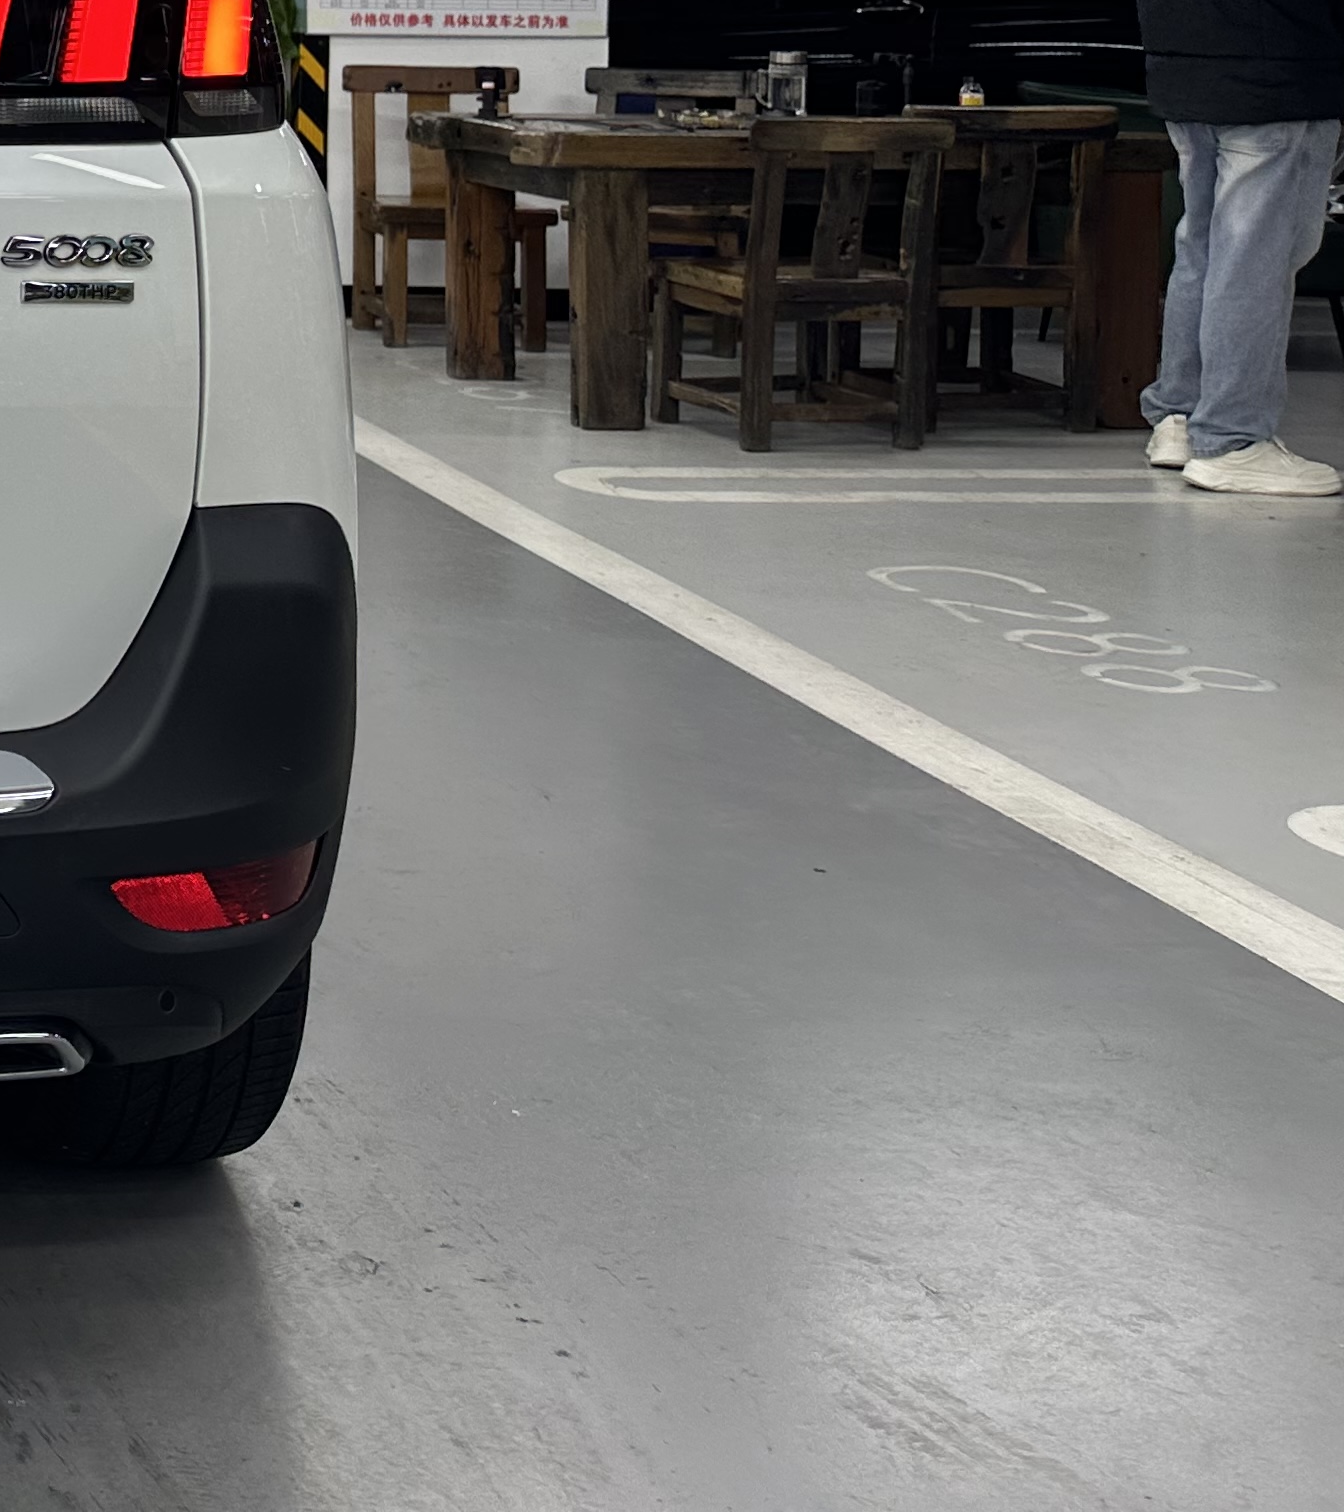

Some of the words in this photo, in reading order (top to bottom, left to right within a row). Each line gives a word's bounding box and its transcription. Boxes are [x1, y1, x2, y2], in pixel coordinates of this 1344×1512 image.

[350, 12, 434, 28] 价格仅供参考
[0, 233, 156, 269] 5008
